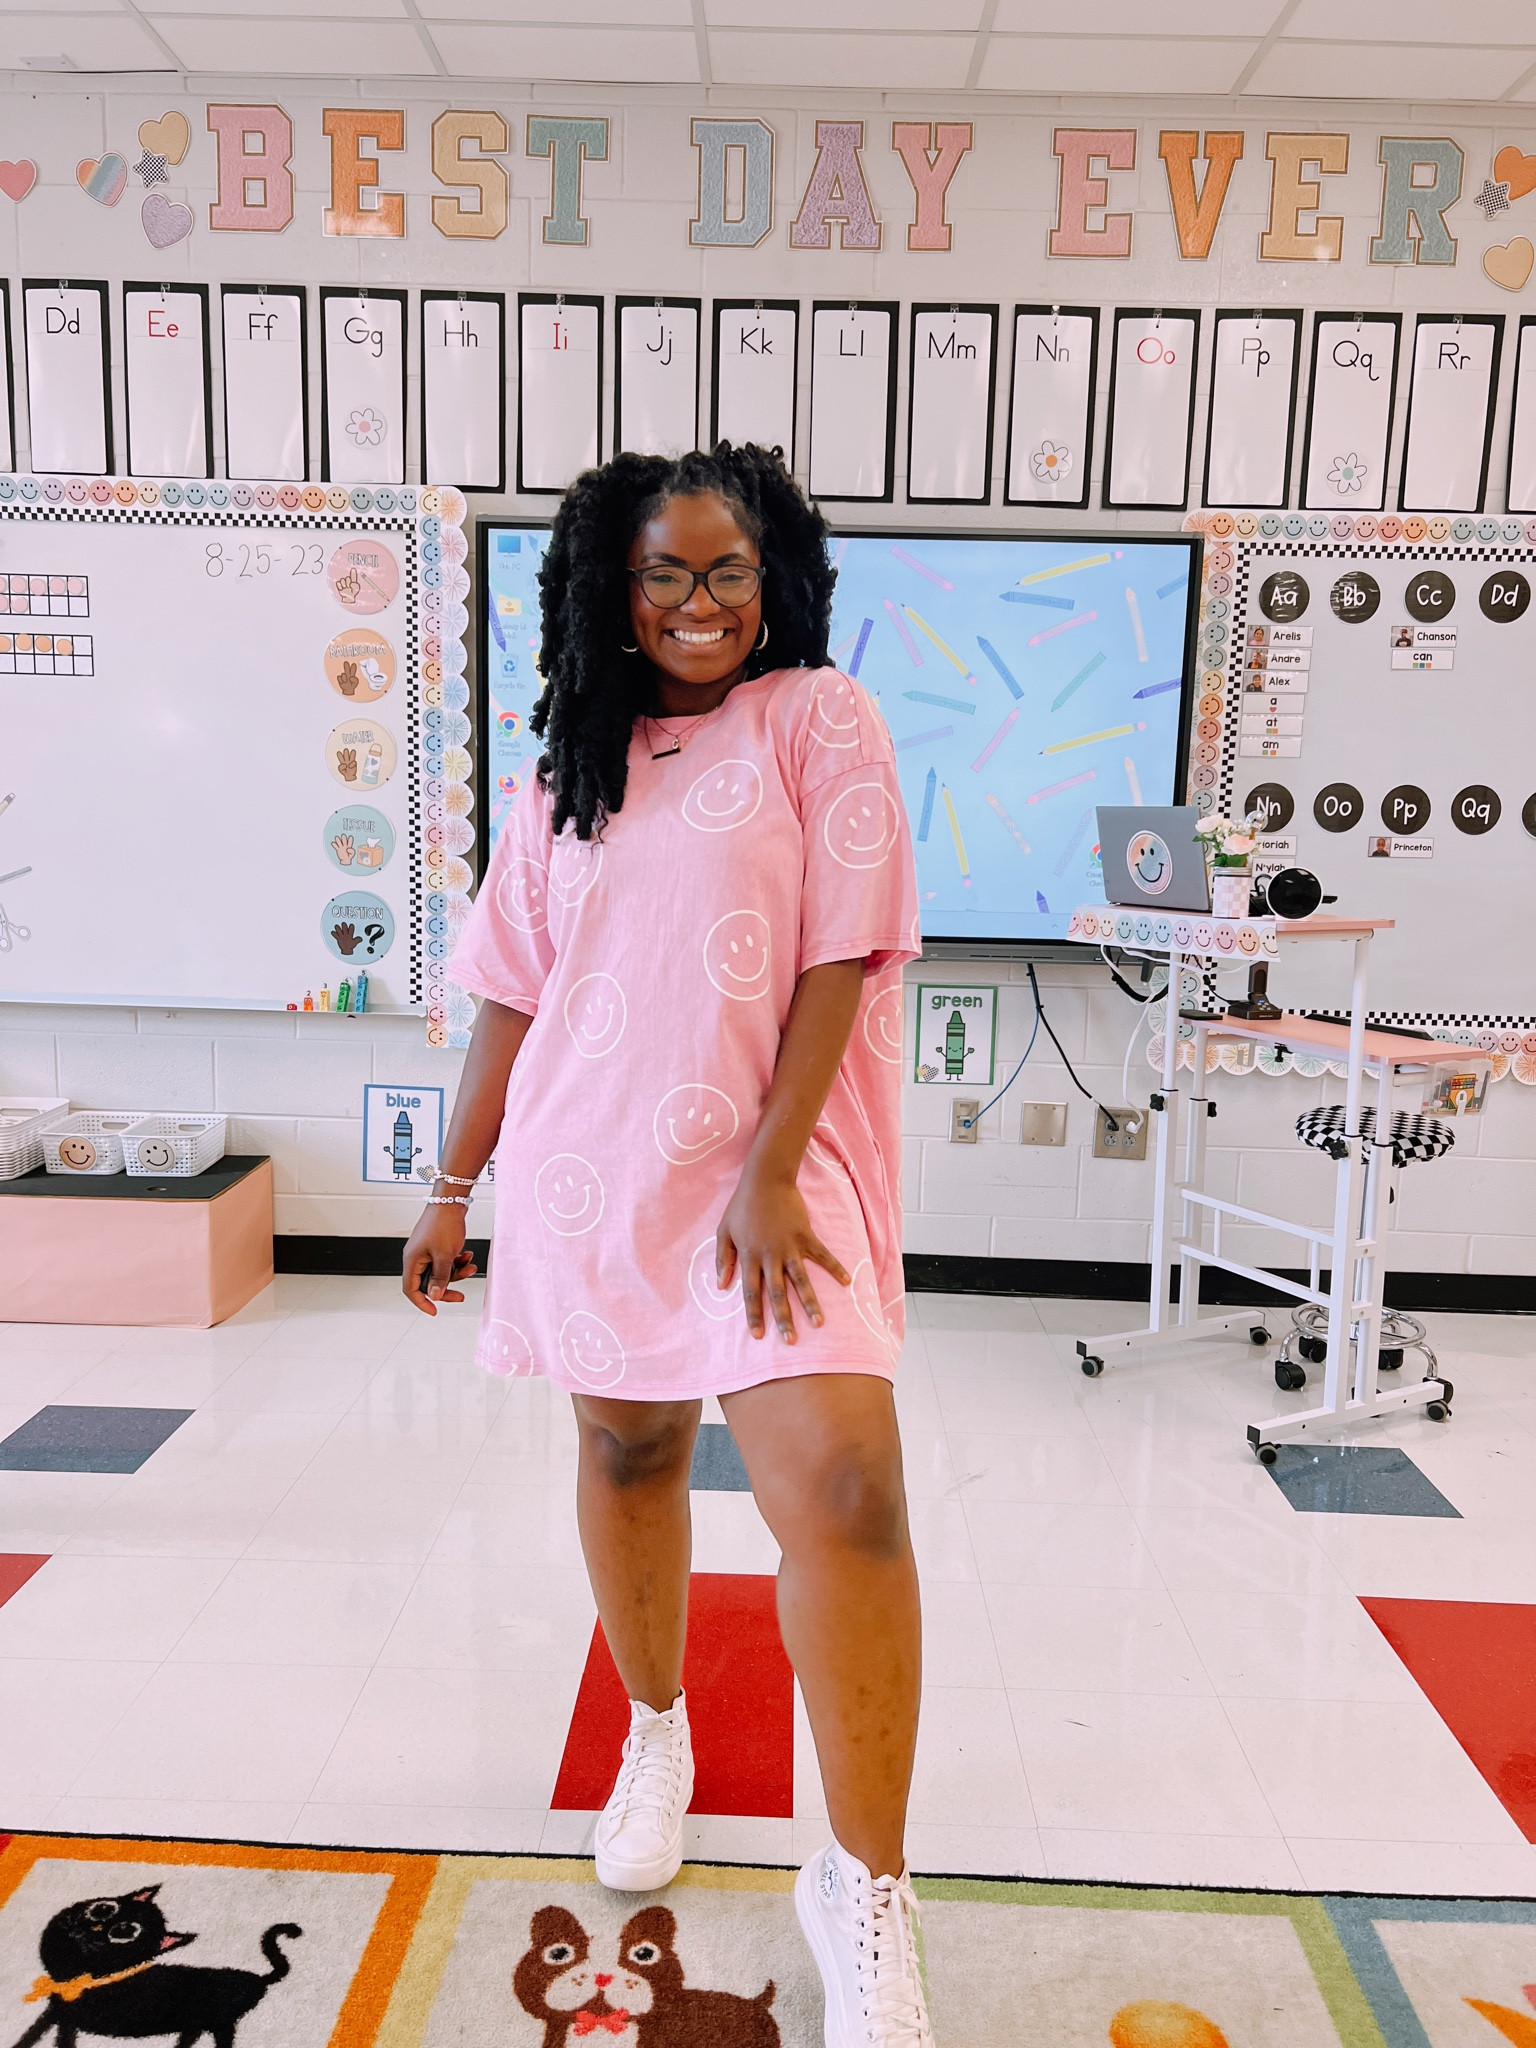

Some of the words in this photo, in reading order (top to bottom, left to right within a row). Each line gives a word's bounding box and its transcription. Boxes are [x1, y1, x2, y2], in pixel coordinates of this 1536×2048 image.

[206, 103, 610, 247] BEST
[689, 117, 974, 252] DAY
[1047, 126, 1465, 265] EVER
[45, 306, 81, 335] Dd
[148, 310, 179, 338] Ee
[248, 313, 279, 341] Ff
[343, 317, 384, 358] Gg
[444, 320, 478, 348] Hh
[553, 322, 568, 350] Ii
[741, 327, 774, 355] Kk
[839, 329, 864, 356] Ll
[646, 325, 673, 366] Jj
[928, 331, 977, 360] Mm
[1036, 334, 1070, 362] Nn
[1136, 336, 1176, 365] Oo
[1438, 342, 1471, 370] Rr
[1241, 337, 1271, 378] Pp
[1332, 340, 1380, 382] Qq
[347, 552, 380, 568] PENCIL
[1270, 585, 1299, 608] Aa
[1342, 585, 1367, 607] Bb
[1416, 584, 1443, 607] Cc
[1490, 584, 1520, 607] Dd
[1273, 631, 1302, 641] Arelis
[1417, 631, 1457, 642] Chanson
[329, 643, 387, 659] BATHROOM
[1270, 653, 1302, 664] Andre
[1413, 651, 1434, 661] can
[1268, 676, 1290, 686] Alex
[1270, 697, 1277, 706] a
[1265, 717, 1279, 727] at
[341, 730, 375, 745] WATER
[1262, 740, 1279, 749] am
[1256, 795, 1282, 817] Nn
[1323, 795, 1352, 817] Oo
[1393, 798, 1417, 825] Pp
[1461, 797, 1491, 825] Qq
[342, 817, 376, 834] TISSUE
[1262, 840, 1290, 849] oriah
[1393, 843, 1433, 853] Princeton
[1255, 863, 1286, 874] N'ylah
[331, 904, 384, 921] QUESTION
[931, 993, 983, 1010] green
[385, 1092, 422, 1108] blue
